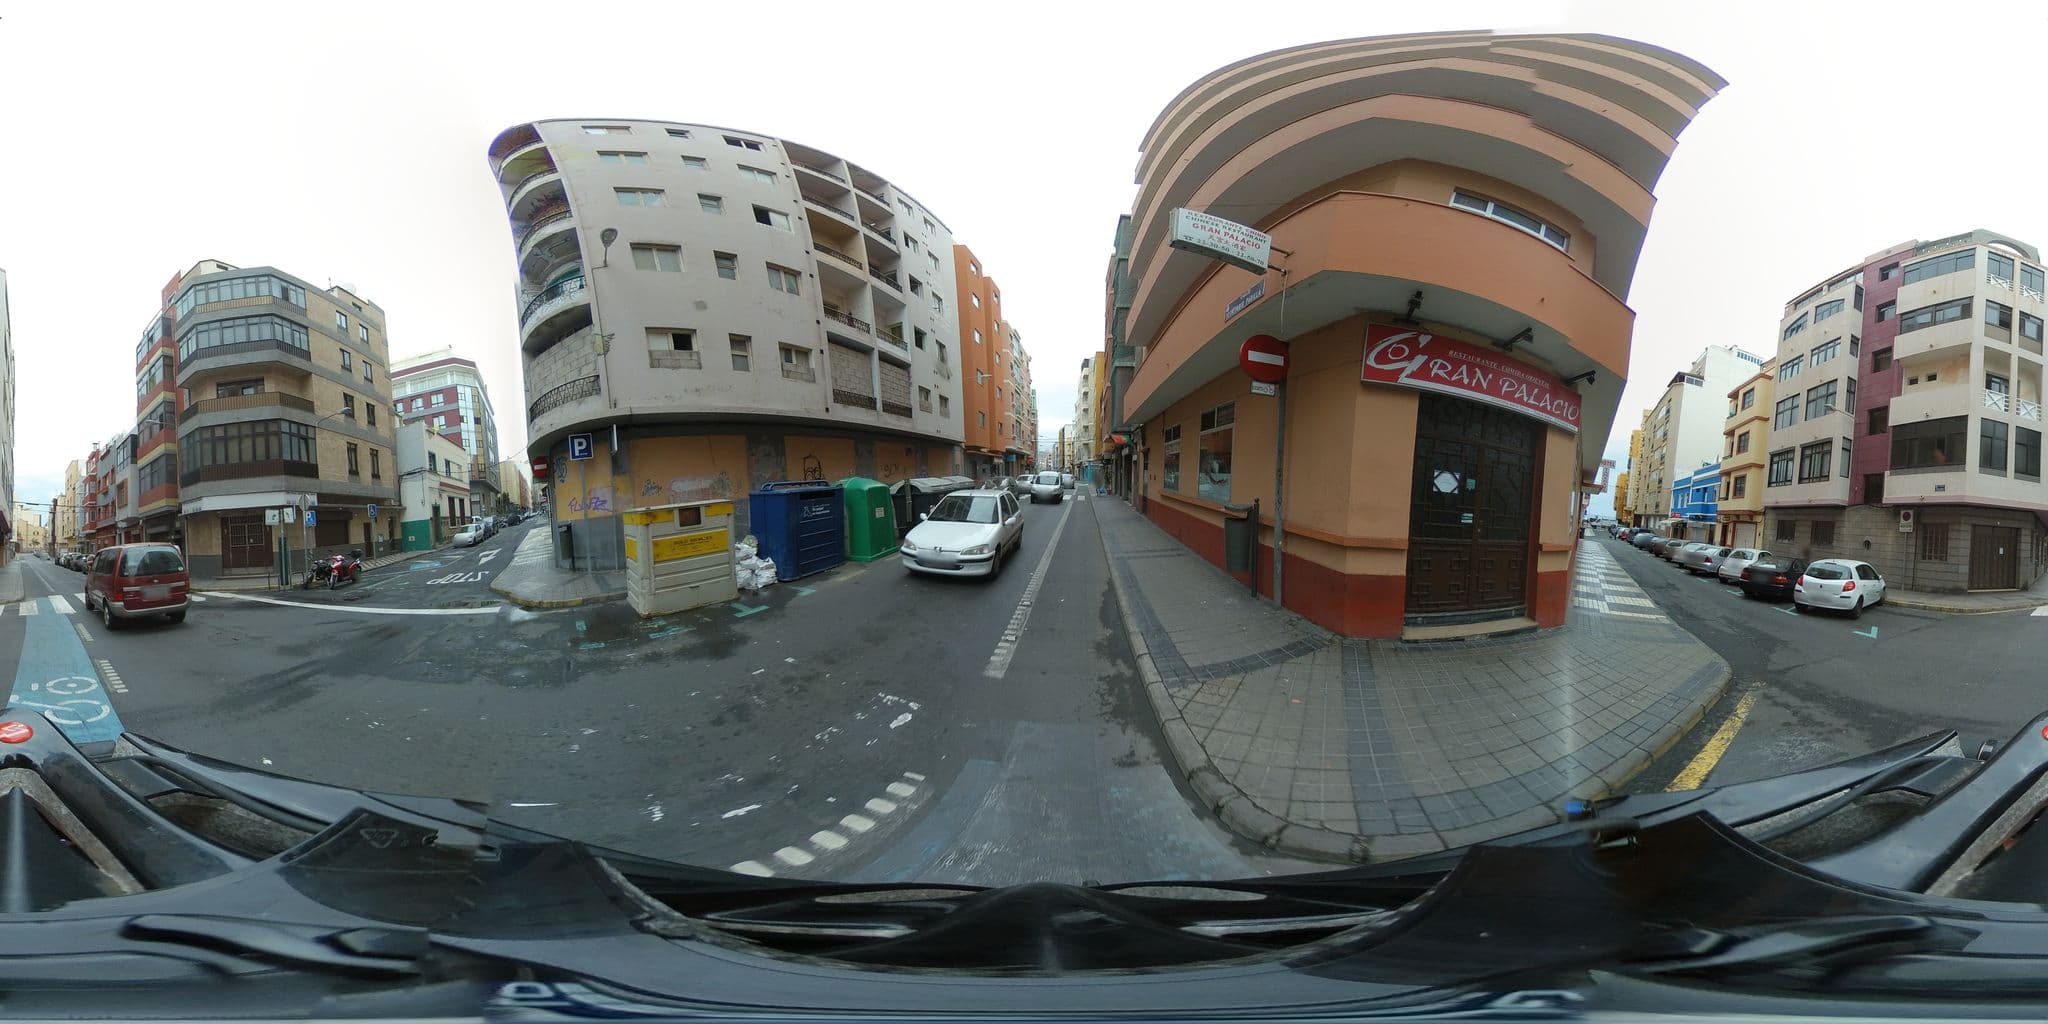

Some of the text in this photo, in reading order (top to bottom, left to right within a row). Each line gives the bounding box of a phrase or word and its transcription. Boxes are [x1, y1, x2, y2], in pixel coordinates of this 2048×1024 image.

[1185, 215, 1220, 229] CHINESE
[1222, 223, 1267, 244] RESTAURANT
[1187, 211, 1243, 230] RESTAURANTE
[1192, 222, 1221, 236] GRAN
[1223, 231, 1261, 250] PALACIO
[1366, 331, 1580, 421] GRAN PALACIO
[574, 438, 587, 456] P
[426, 571, 490, 585] STOP
